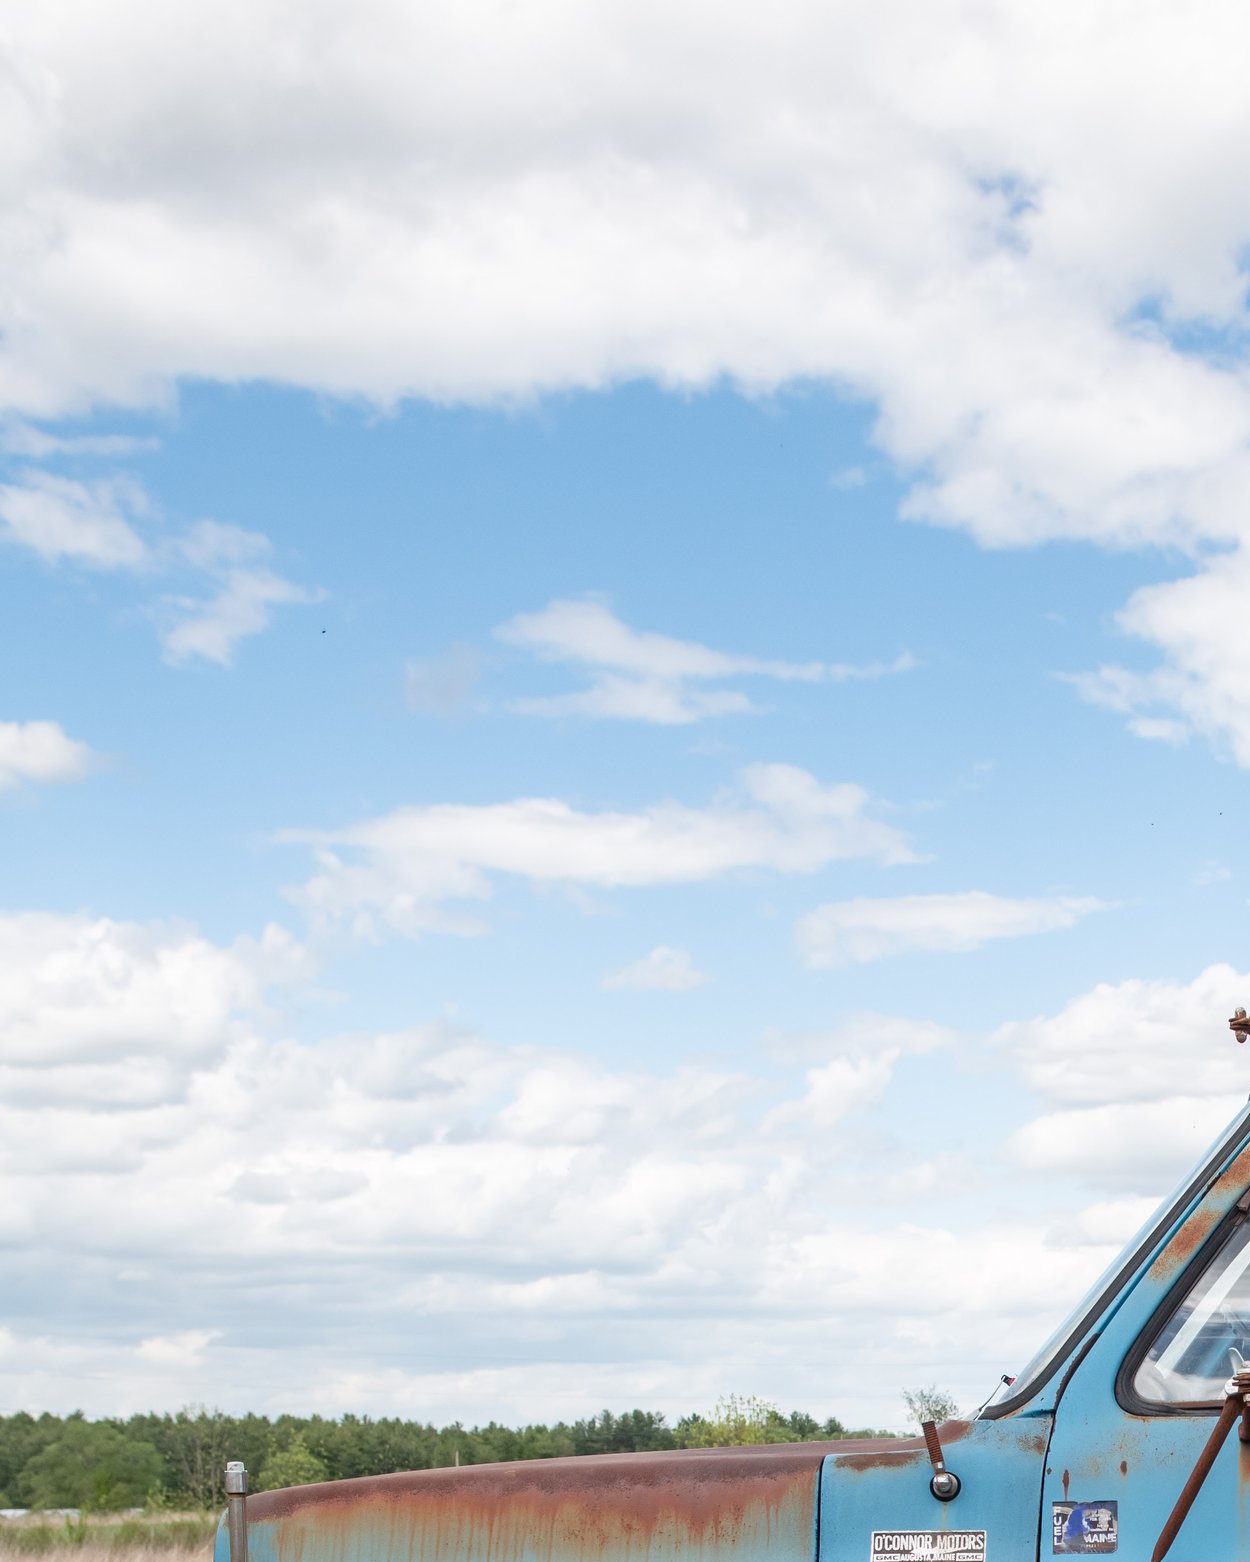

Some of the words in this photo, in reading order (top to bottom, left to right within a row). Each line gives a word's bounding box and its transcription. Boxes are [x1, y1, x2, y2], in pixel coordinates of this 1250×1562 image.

[874, 1534, 934, 1551] O'CONNOR
[935, 1533, 985, 1550] MOTORS
[875, 1553, 900, 1562] GMC
[958, 1552, 983, 1561] GMC
